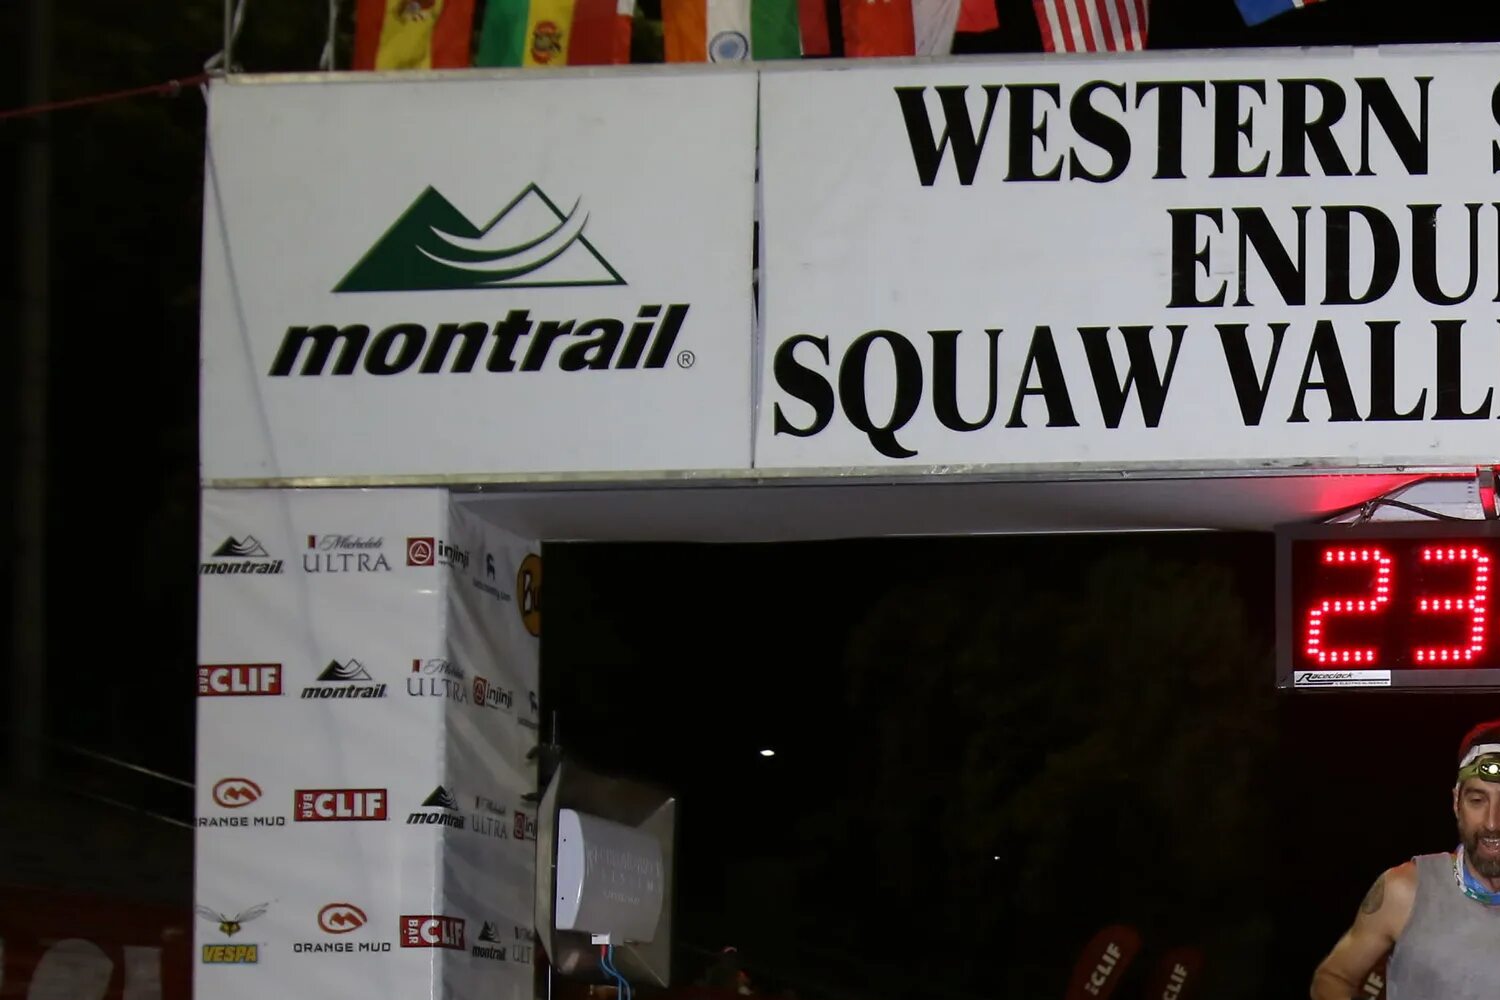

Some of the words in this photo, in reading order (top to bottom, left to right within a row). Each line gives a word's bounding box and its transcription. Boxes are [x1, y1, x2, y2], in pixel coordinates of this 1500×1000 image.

[893, 75, 1434, 187] WESTERN
[269, 303, 690, 376] montrail
[773, 323, 1187, 459] SQUAW
[303, 554, 390, 573] ULTRA
[438, 541, 470, 566] injinji
[199, 560, 283, 575] montrail
[210, 668, 278, 693] CLIF
[300, 683, 386, 698] montrail
[407, 678, 470, 704] ULTRA
[486, 684, 513, 709] injinji
[302, 794, 313, 818] BAR
[315, 792, 382, 817] CLIF
[254, 816, 285, 826] MUD
[407, 813, 465, 829] montrail
[472, 816, 507, 839] ULTRA
[421, 920, 464, 946] CLIF
[203, 945, 258, 964] VESPA
[293, 942, 353, 953] ORANGE
[358, 942, 391, 953] MUD
[472, 945, 507, 960] montrail
[1092, 942, 1123, 987] CLIF
